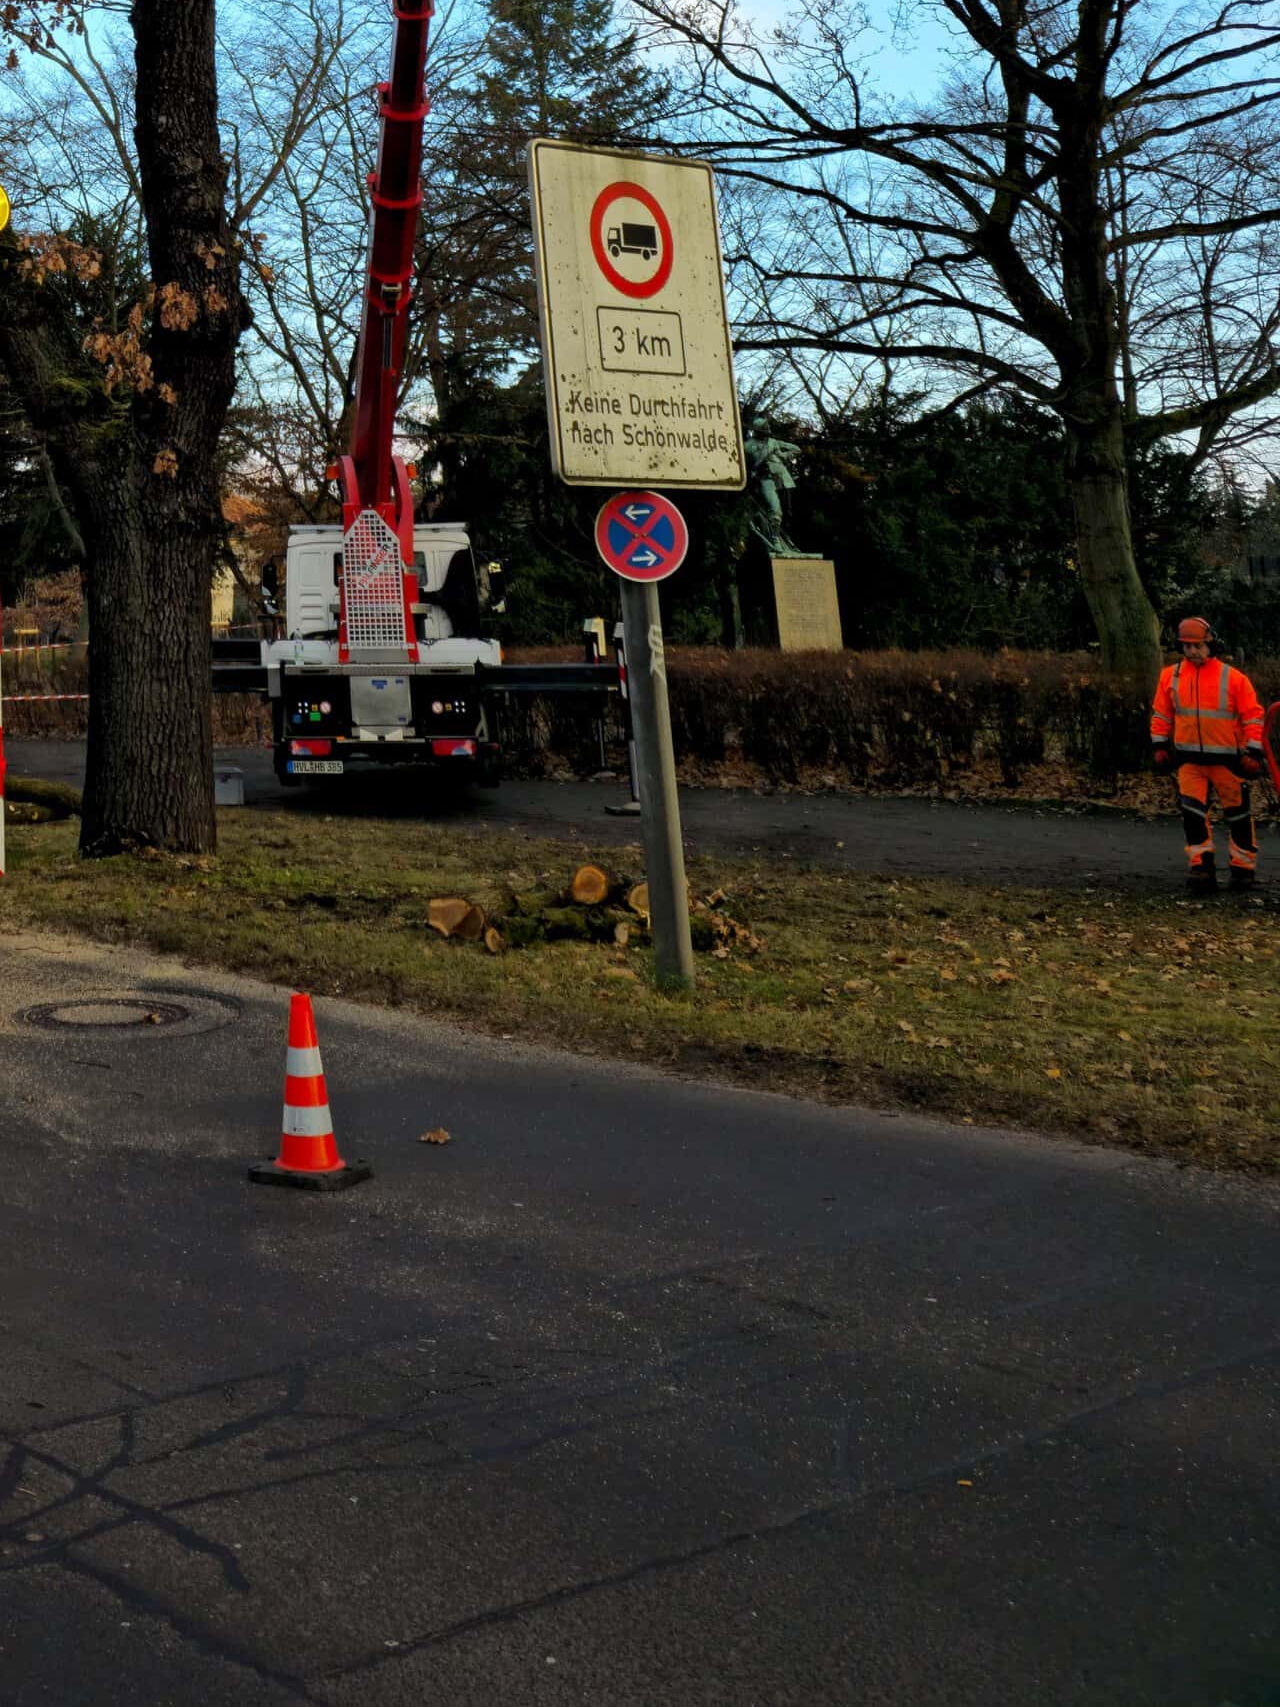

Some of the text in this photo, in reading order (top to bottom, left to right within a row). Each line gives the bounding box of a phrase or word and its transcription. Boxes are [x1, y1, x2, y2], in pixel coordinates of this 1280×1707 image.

[612, 325, 672, 357] 3 km
[570, 390, 723, 420] Keine Durchfahrt
[572, 421, 729, 451] nach Schönwalde
